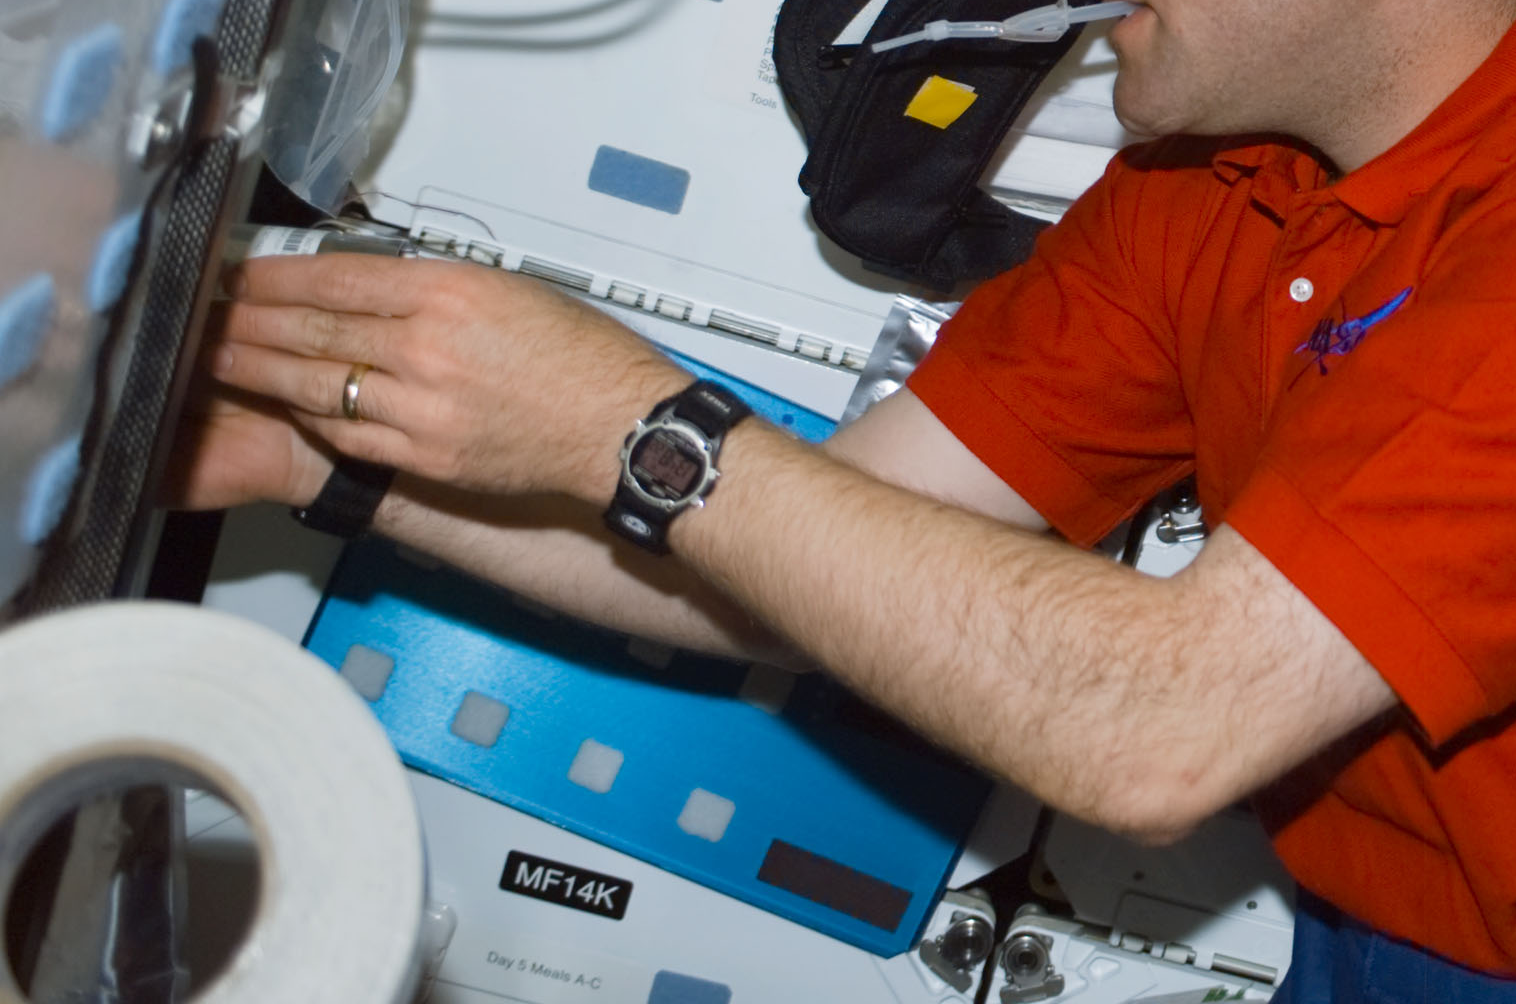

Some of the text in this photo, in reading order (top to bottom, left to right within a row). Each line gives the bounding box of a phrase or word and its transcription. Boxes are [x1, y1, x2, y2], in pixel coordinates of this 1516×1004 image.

[750, 92, 778, 109] Tools
[514, 861, 620, 910] MF14K
[486, 951, 602, 990] Day 5 Meals A-C
